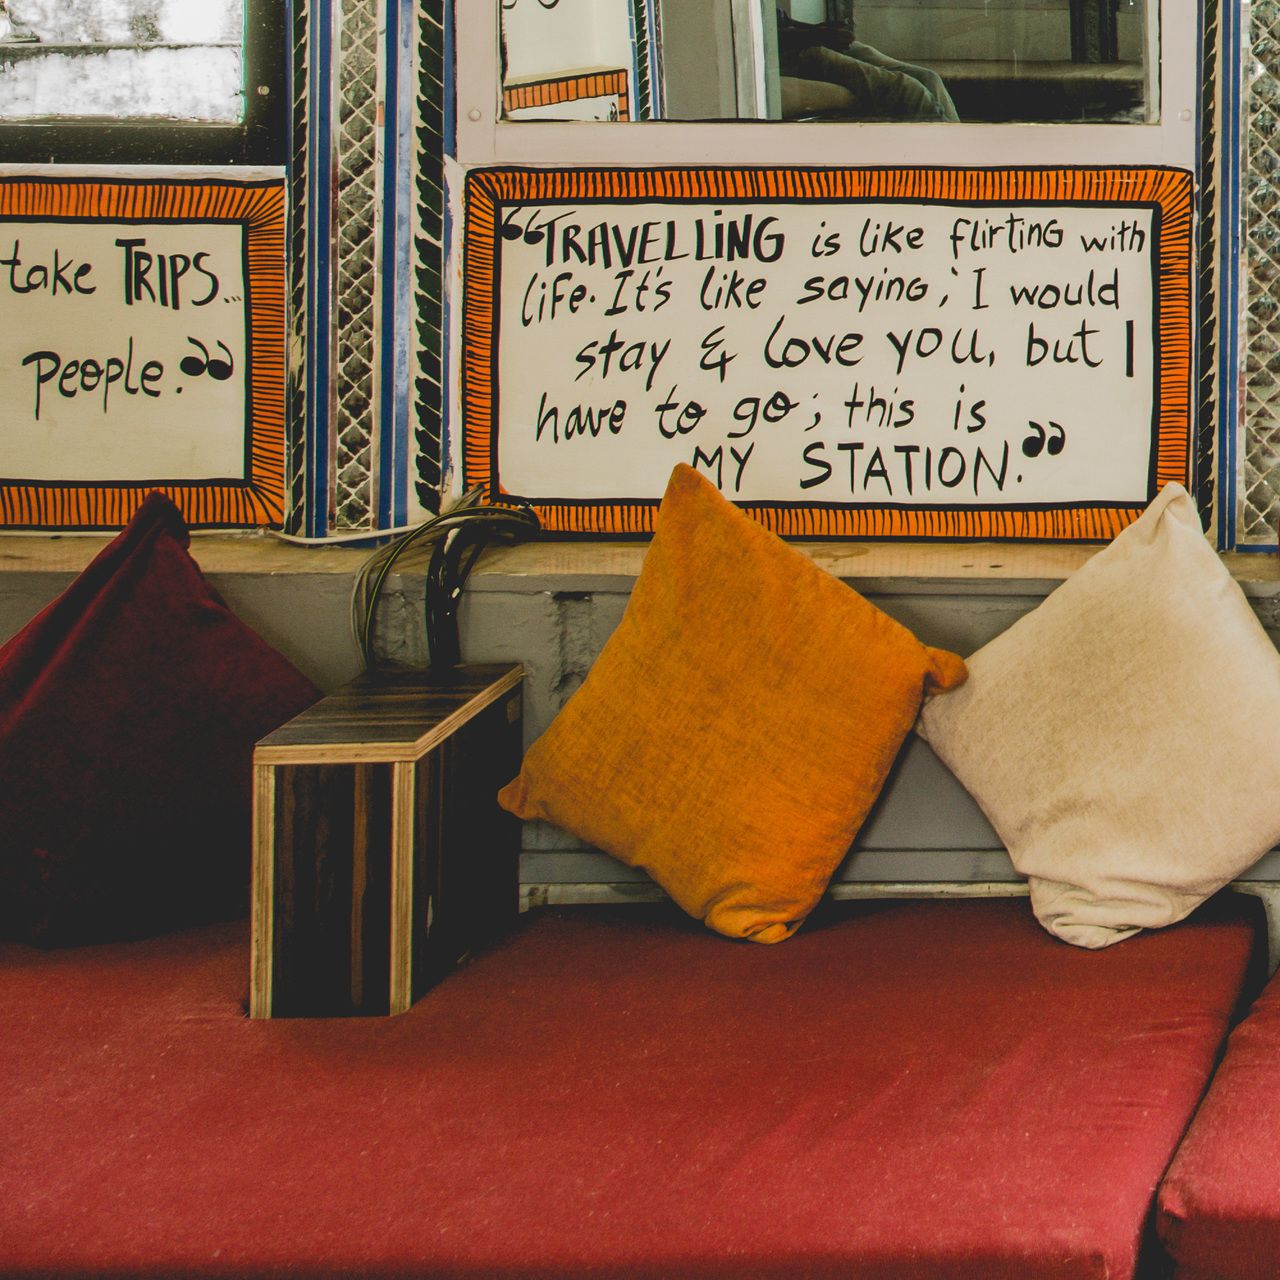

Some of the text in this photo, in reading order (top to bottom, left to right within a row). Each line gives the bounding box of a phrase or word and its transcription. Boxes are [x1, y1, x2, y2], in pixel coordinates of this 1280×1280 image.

[811, 221, 840, 257] is
[859, 218, 923, 257] like
[1080, 220, 1146, 253] with
[1, 239, 97, 295] take
[699, 265, 767, 310] like
[1010, 268, 1119, 310] would
[574, 328, 671, 392] stay
[699, 325, 738, 383] &
[764, 314, 864, 369] love
[1026, 318, 1104, 367] but
[1125, 319, 1135, 377] I
[536, 391, 627, 444] have
[654, 384, 707, 439] to
[844, 382, 915, 428] this
[953, 383, 987, 433] is
[692, 442, 755, 493] MY
